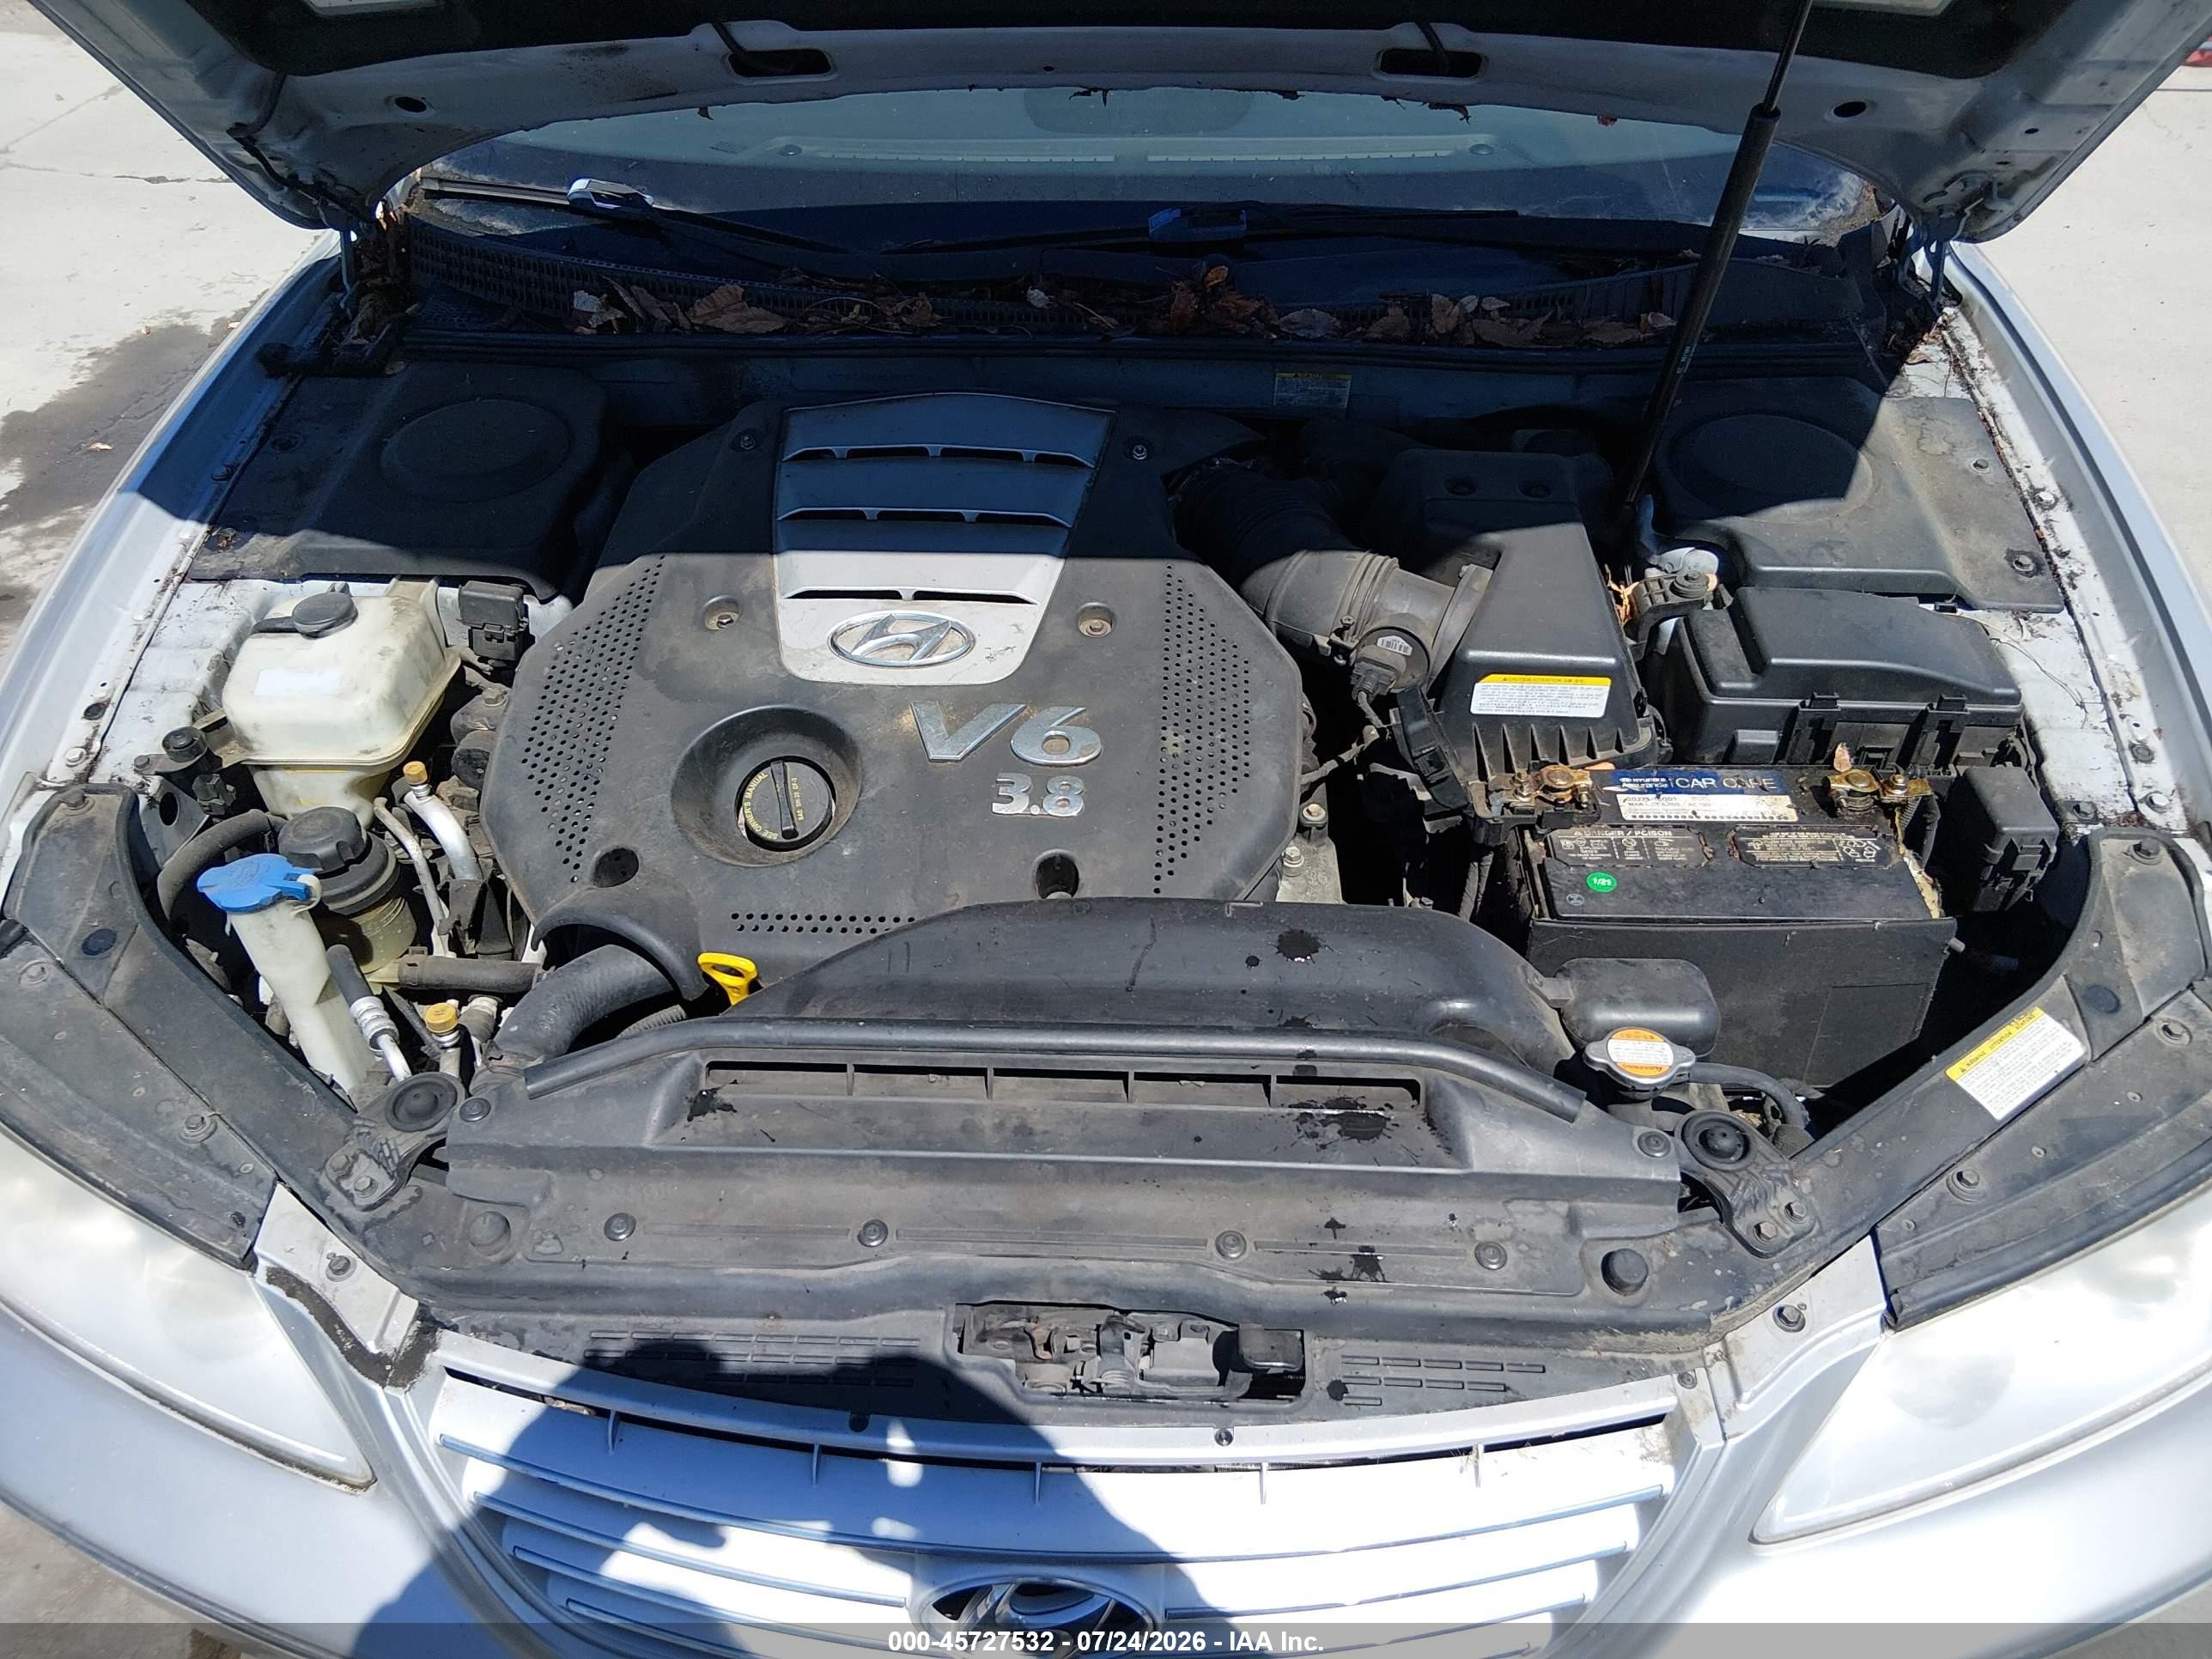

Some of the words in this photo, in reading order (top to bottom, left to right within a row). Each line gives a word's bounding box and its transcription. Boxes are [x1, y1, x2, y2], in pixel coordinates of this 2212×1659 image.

[910, 701, 1102, 767] V6
[744, 772, 769, 799] MANUAL
[992, 773, 1085, 817] 3.8
[1675, 777, 1718, 788] CAR
[744, 801, 763, 832] OWNER'S
[762, 830, 779, 840] SEE
